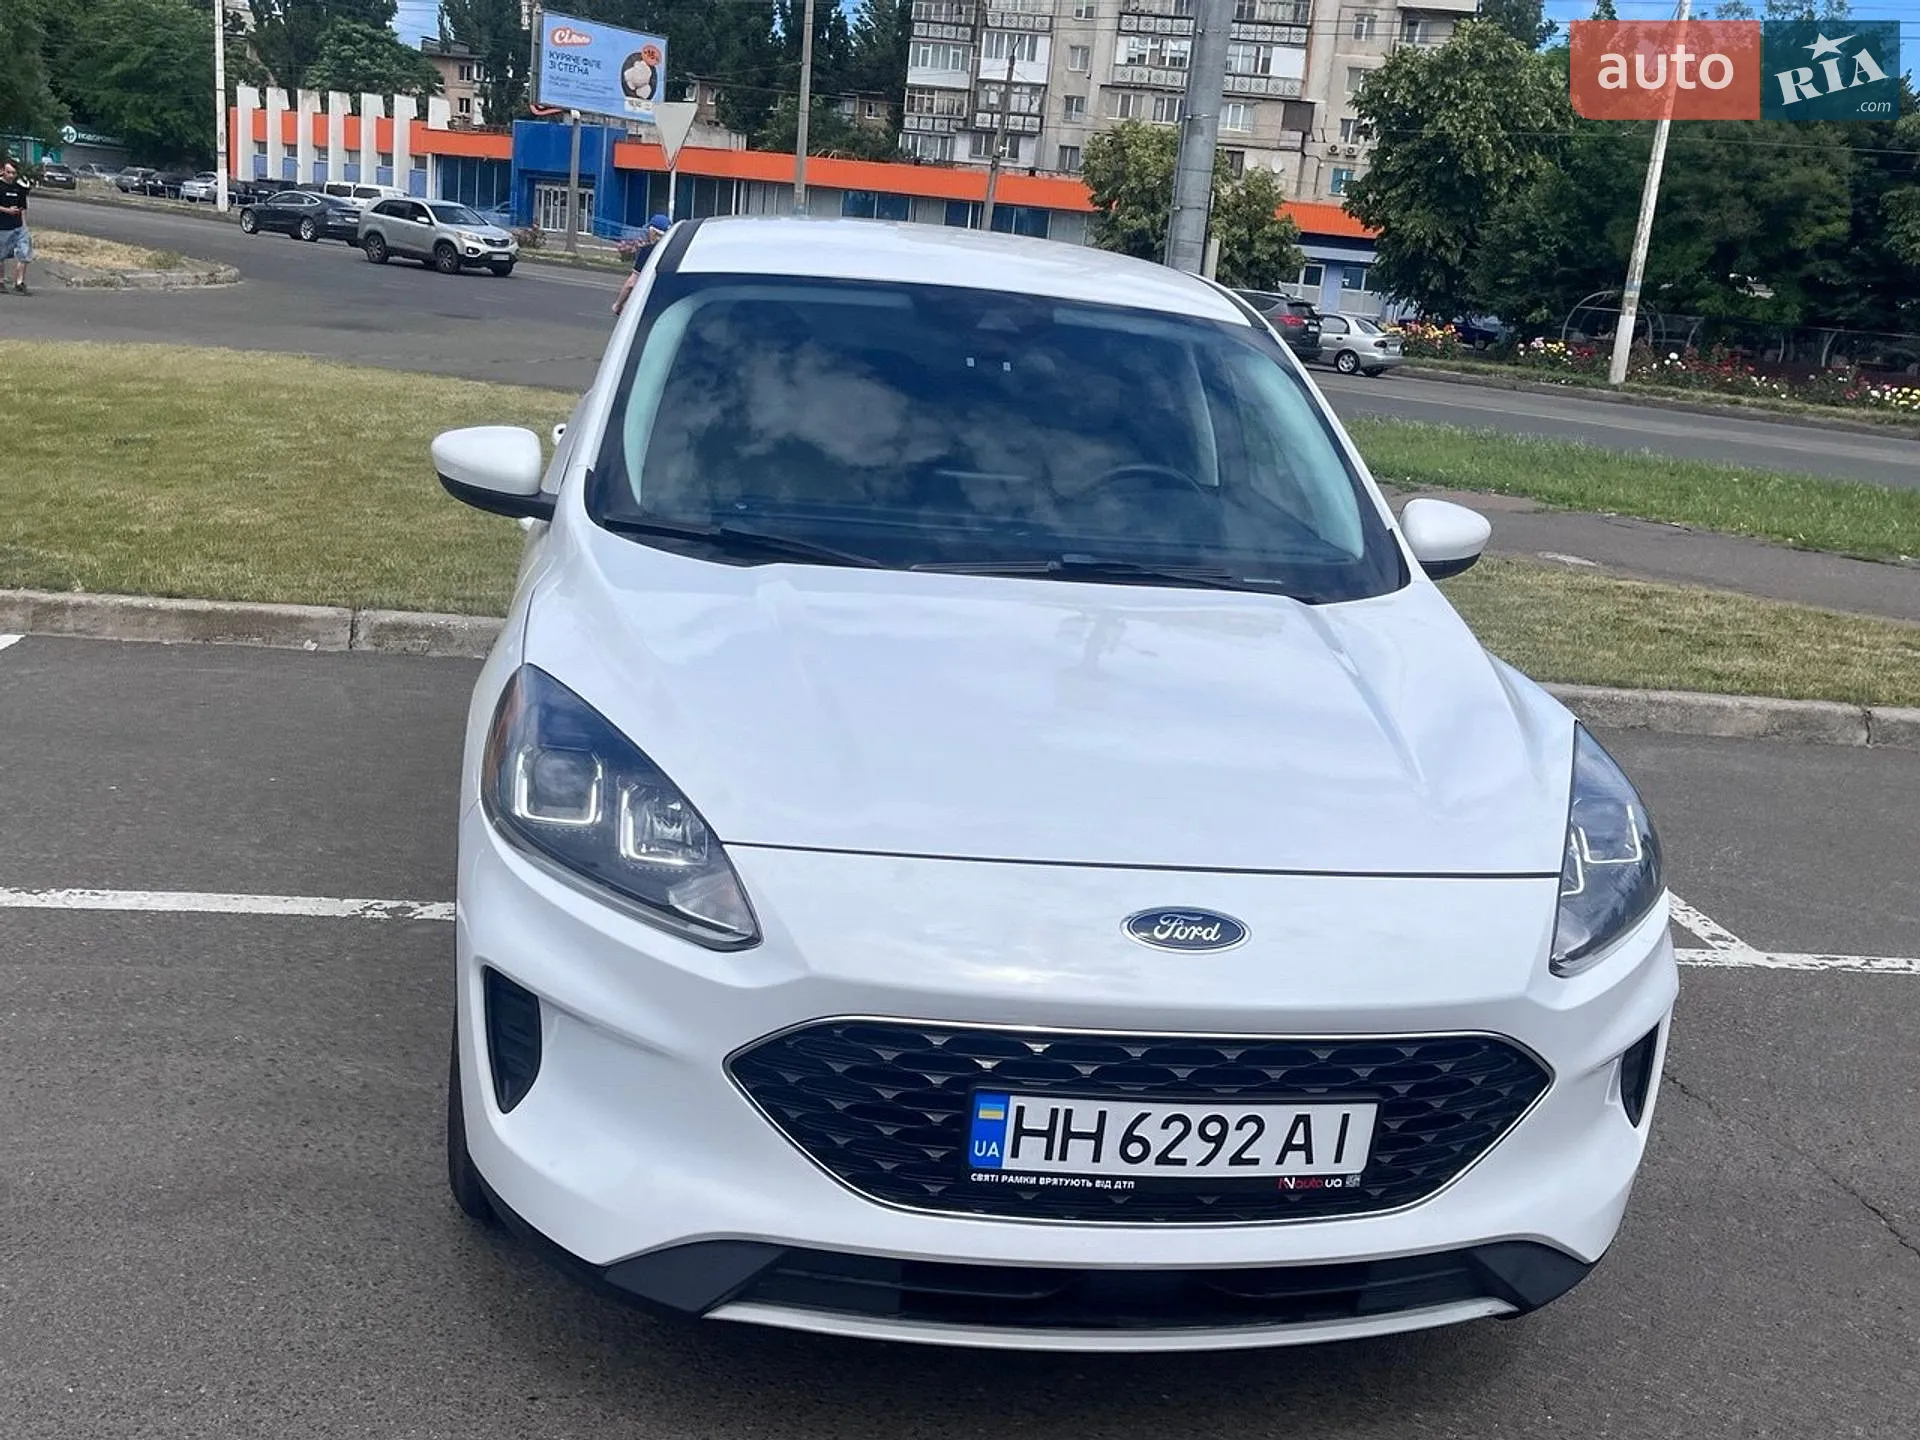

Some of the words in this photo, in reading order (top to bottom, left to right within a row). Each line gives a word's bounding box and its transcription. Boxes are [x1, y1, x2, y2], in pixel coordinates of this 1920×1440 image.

[558, 61, 590, 75] СТЕГНА
[1153, 913, 1221, 941] Ford
[1118, 1112, 1266, 1167] 6292
[973, 1140, 1001, 1158] UA
[970, 1173, 999, 1183] СВЯТІ
[1001, 1174, 1037, 1185] РАМКИ
[1039, 1177, 1093, 1188] ВРЯТУЮТЬ
[1095, 1179, 1112, 1189] ВІД
[1113, 1181, 1135, 1190] ДТП
